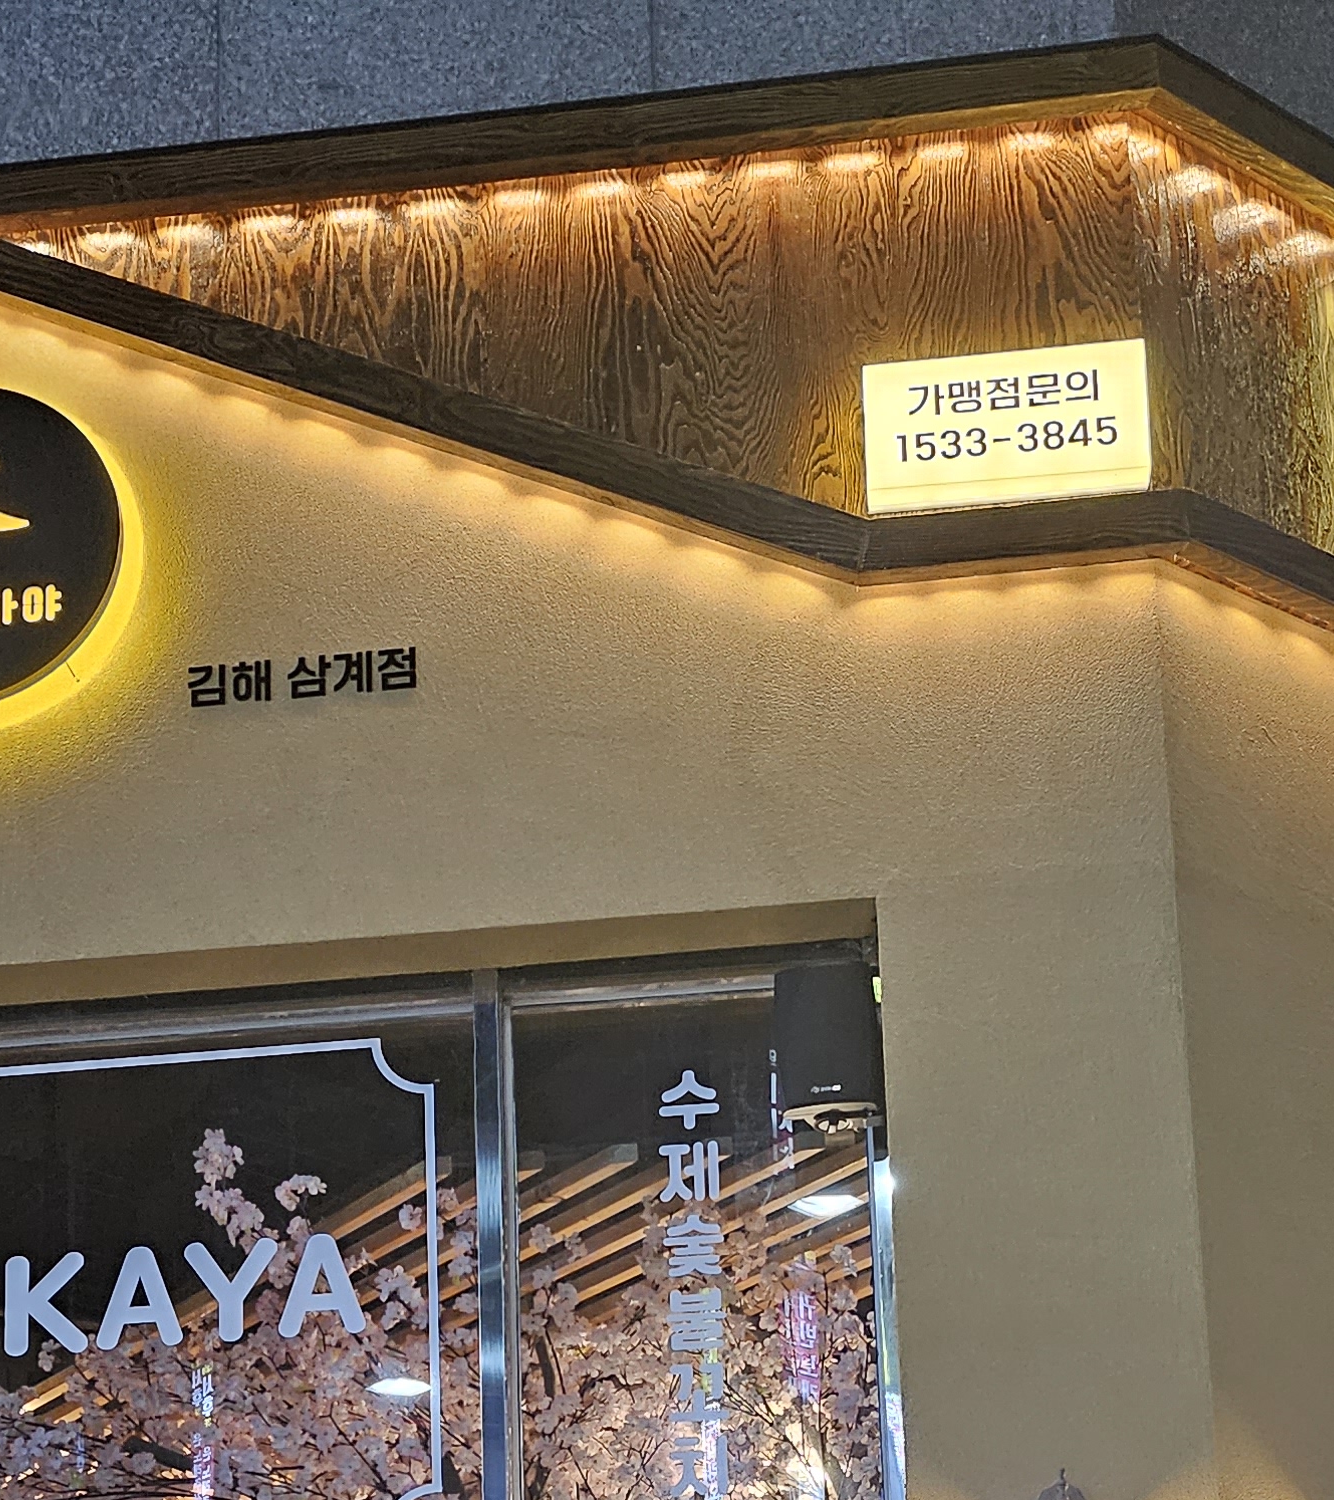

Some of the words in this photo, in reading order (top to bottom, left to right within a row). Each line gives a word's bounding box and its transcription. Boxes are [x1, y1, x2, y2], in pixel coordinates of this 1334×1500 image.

[907, 369, 1100, 417] 가맹점문의
[896, 416, 1118, 463] 1533-3845
[186, 659, 272, 709] 김해
[287, 646, 419, 700] 삼계점
